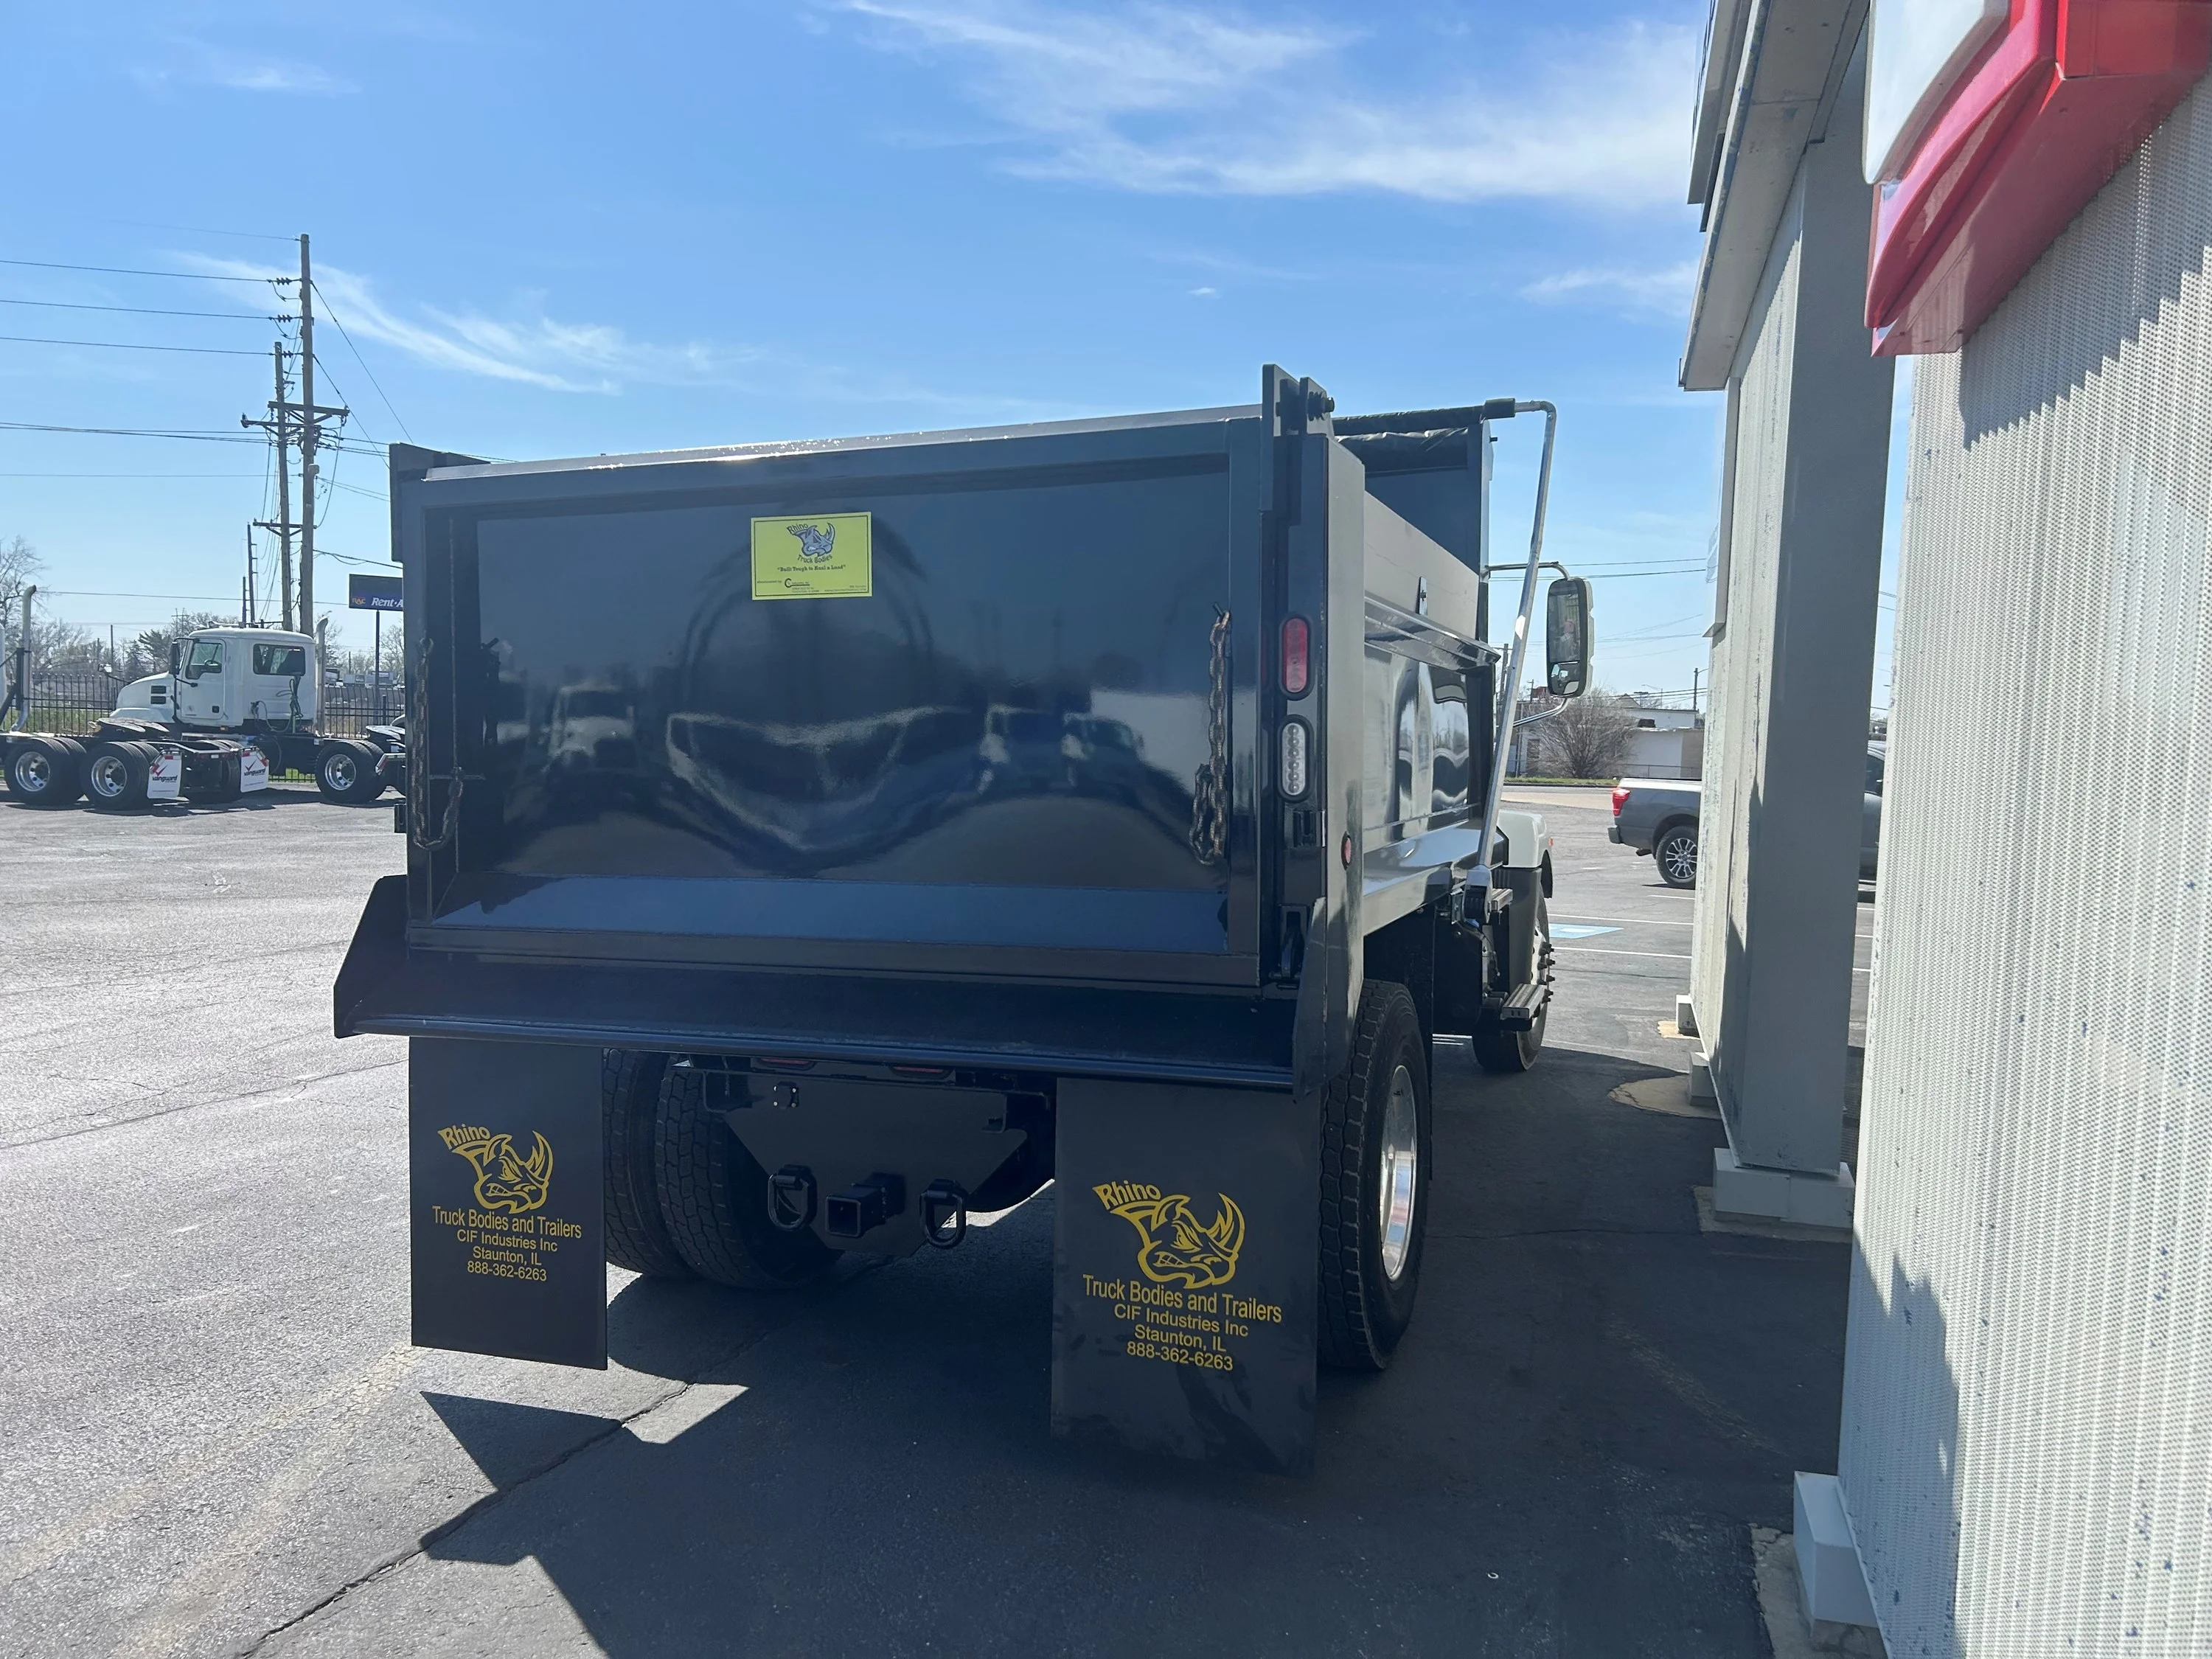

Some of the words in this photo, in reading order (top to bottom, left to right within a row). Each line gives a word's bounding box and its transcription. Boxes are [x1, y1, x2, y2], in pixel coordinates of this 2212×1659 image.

[786, 524, 808, 535] Rhino
[798, 554, 813, 563] Truck
[815, 554, 832, 563] Bodies
[437, 1124, 490, 1150] Rhino
[1092, 1180, 1161, 1210] Rhino
[432, 1206, 465, 1226] Truck
[468, 1208, 509, 1231] Bodies
[512, 1216, 534, 1234] and
[538, 1217, 582, 1239] Trailers
[457, 1229, 478, 1243] CIF
[481, 1232, 536, 1250] Industries
[540, 1238, 557, 1252] Inc
[473, 1245, 526, 1265] Staunton,
[531, 1253, 542, 1265] IL
[467, 1260, 547, 1281] 888-362-6263
[1083, 1274, 1125, 1300] Truck
[1130, 1280, 1183, 1309] Bodies
[1188, 1292, 1217, 1314] and
[1222, 1293, 1282, 1324] Trailers
[1114, 1303, 1141, 1321] CIF
[1146, 1307, 1220, 1332] Industries
[1225, 1320, 1248, 1337] Inc
[1134, 1324, 1207, 1351] Staunton,
[1212, 1336, 1226, 1352] IL
[1127, 1340, 1234, 1371] 888-362-6263
